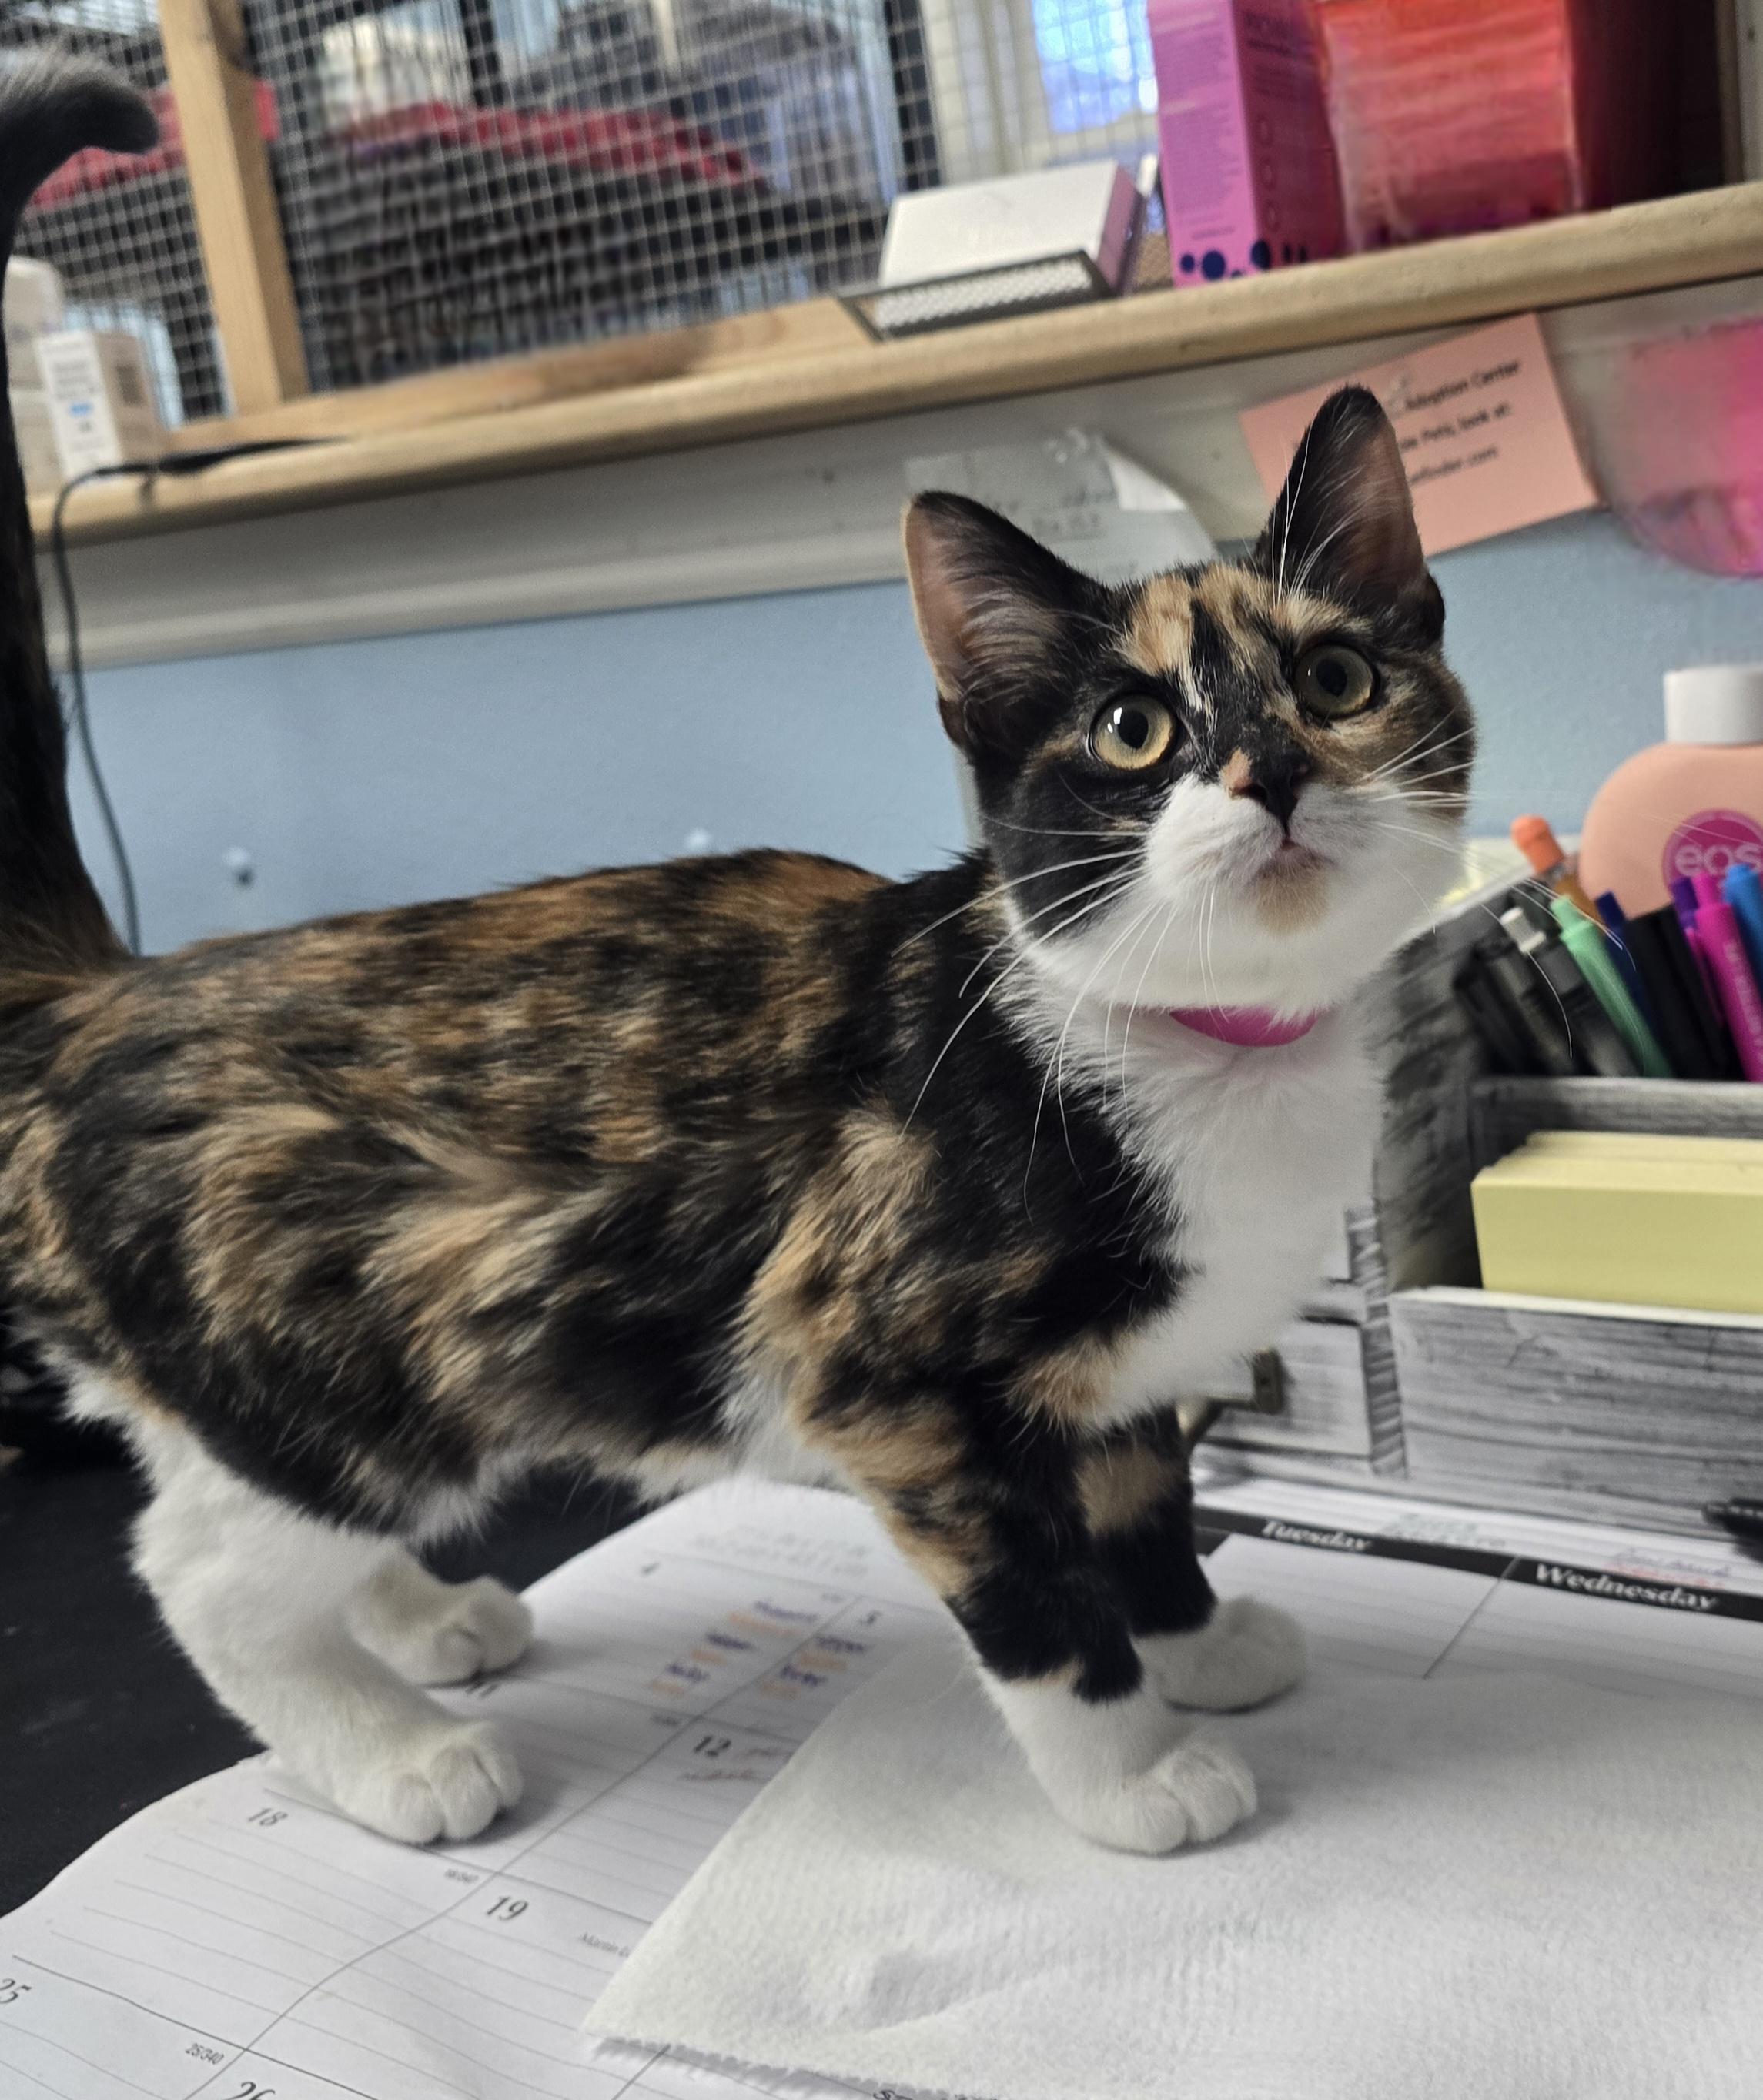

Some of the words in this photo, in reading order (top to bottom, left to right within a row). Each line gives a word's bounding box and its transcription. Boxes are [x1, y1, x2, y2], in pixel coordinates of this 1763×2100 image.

[1405, 380, 1468, 411] Adoption
[1470, 360, 1520, 386] Center
[1674, 842, 1763, 878] eos
[1261, 1519, 1373, 1551] Tuesday
[1535, 1562, 1718, 1610] Wednesday
[692, 1734, 732, 1760] 12
[247, 1806, 289, 1827] 18
[485, 1894, 530, 1921] 19
